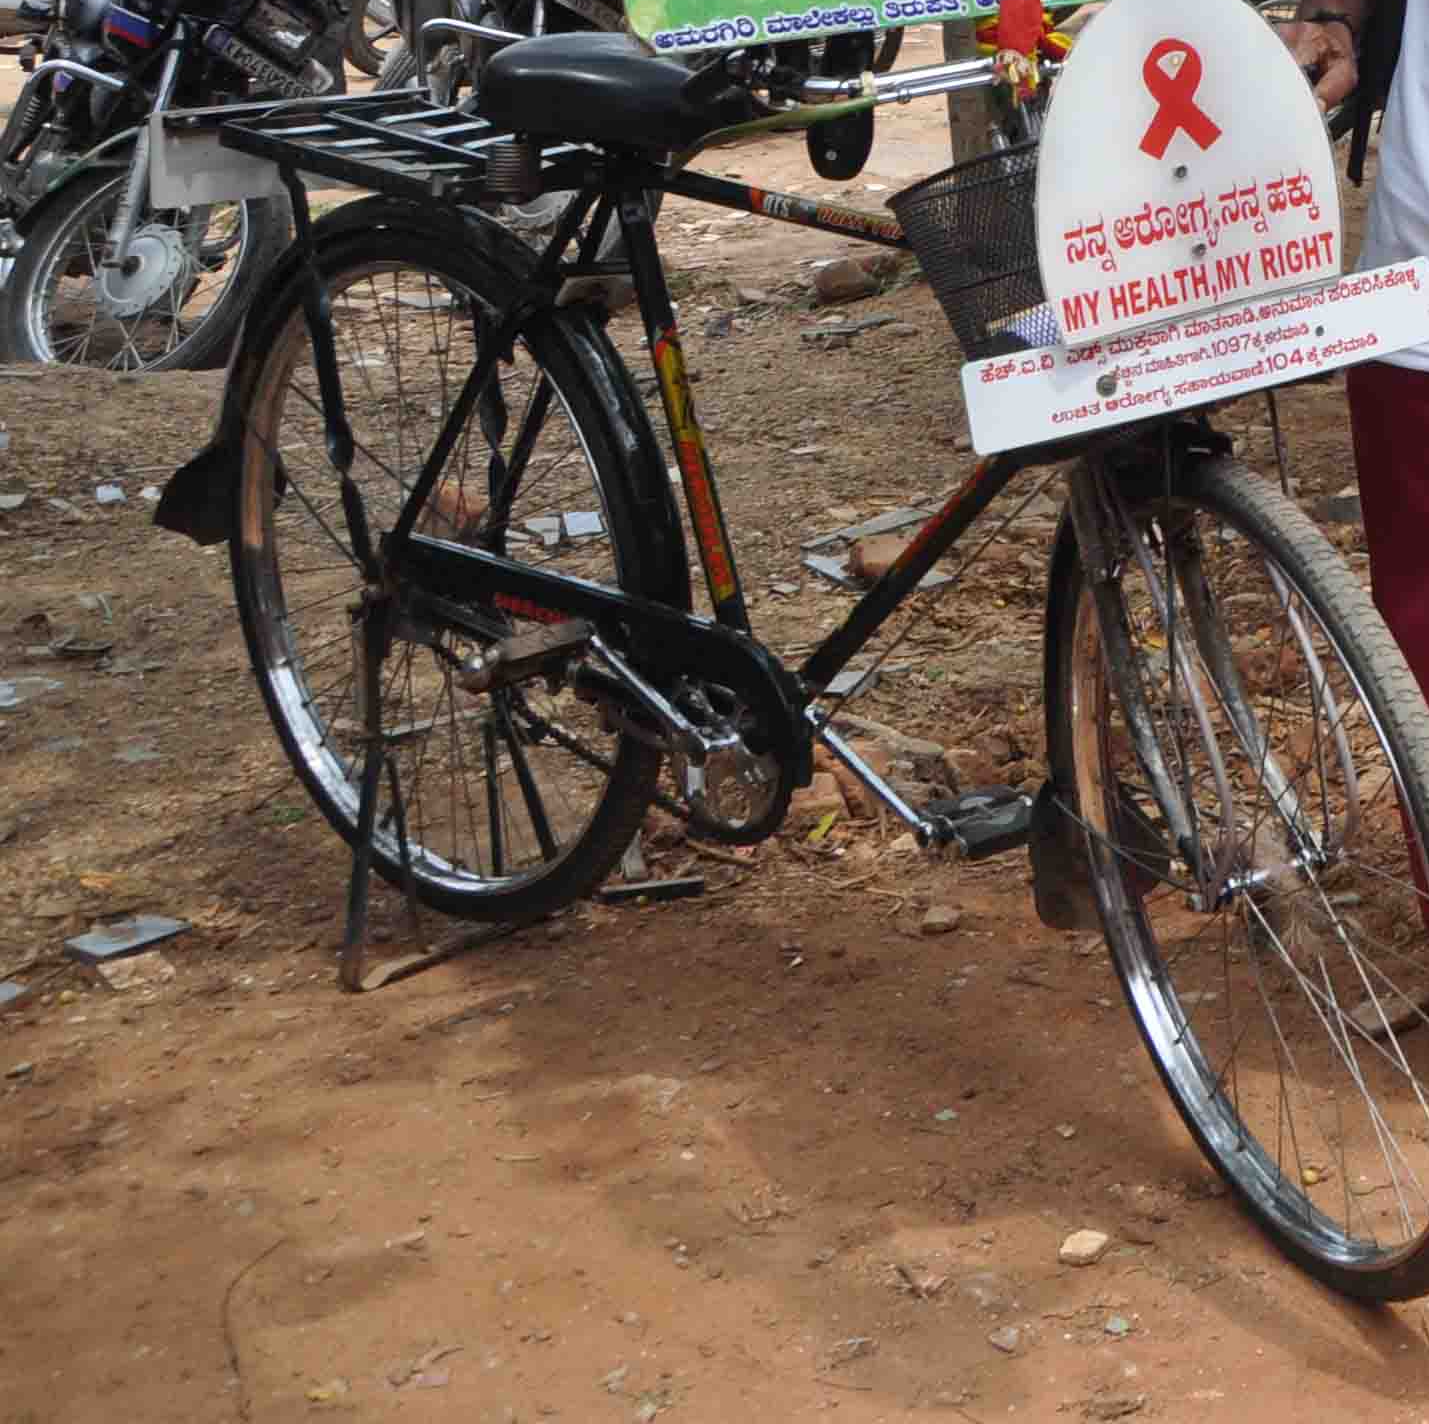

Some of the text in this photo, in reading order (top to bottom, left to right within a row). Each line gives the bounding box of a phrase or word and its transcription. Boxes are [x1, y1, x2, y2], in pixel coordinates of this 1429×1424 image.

[655, 17, 755, 49] ಅಮರಗಿರಿ
[1064, 213, 1117, 272] ನನ್ನ
[1266, 167, 1320, 221] ಹಕ್ಕು
[1062, 290, 1099, 332] MY
[1260, 232, 1334, 280] RIGHT
[1051, 402, 1101, 424] ಉಚಿತ
